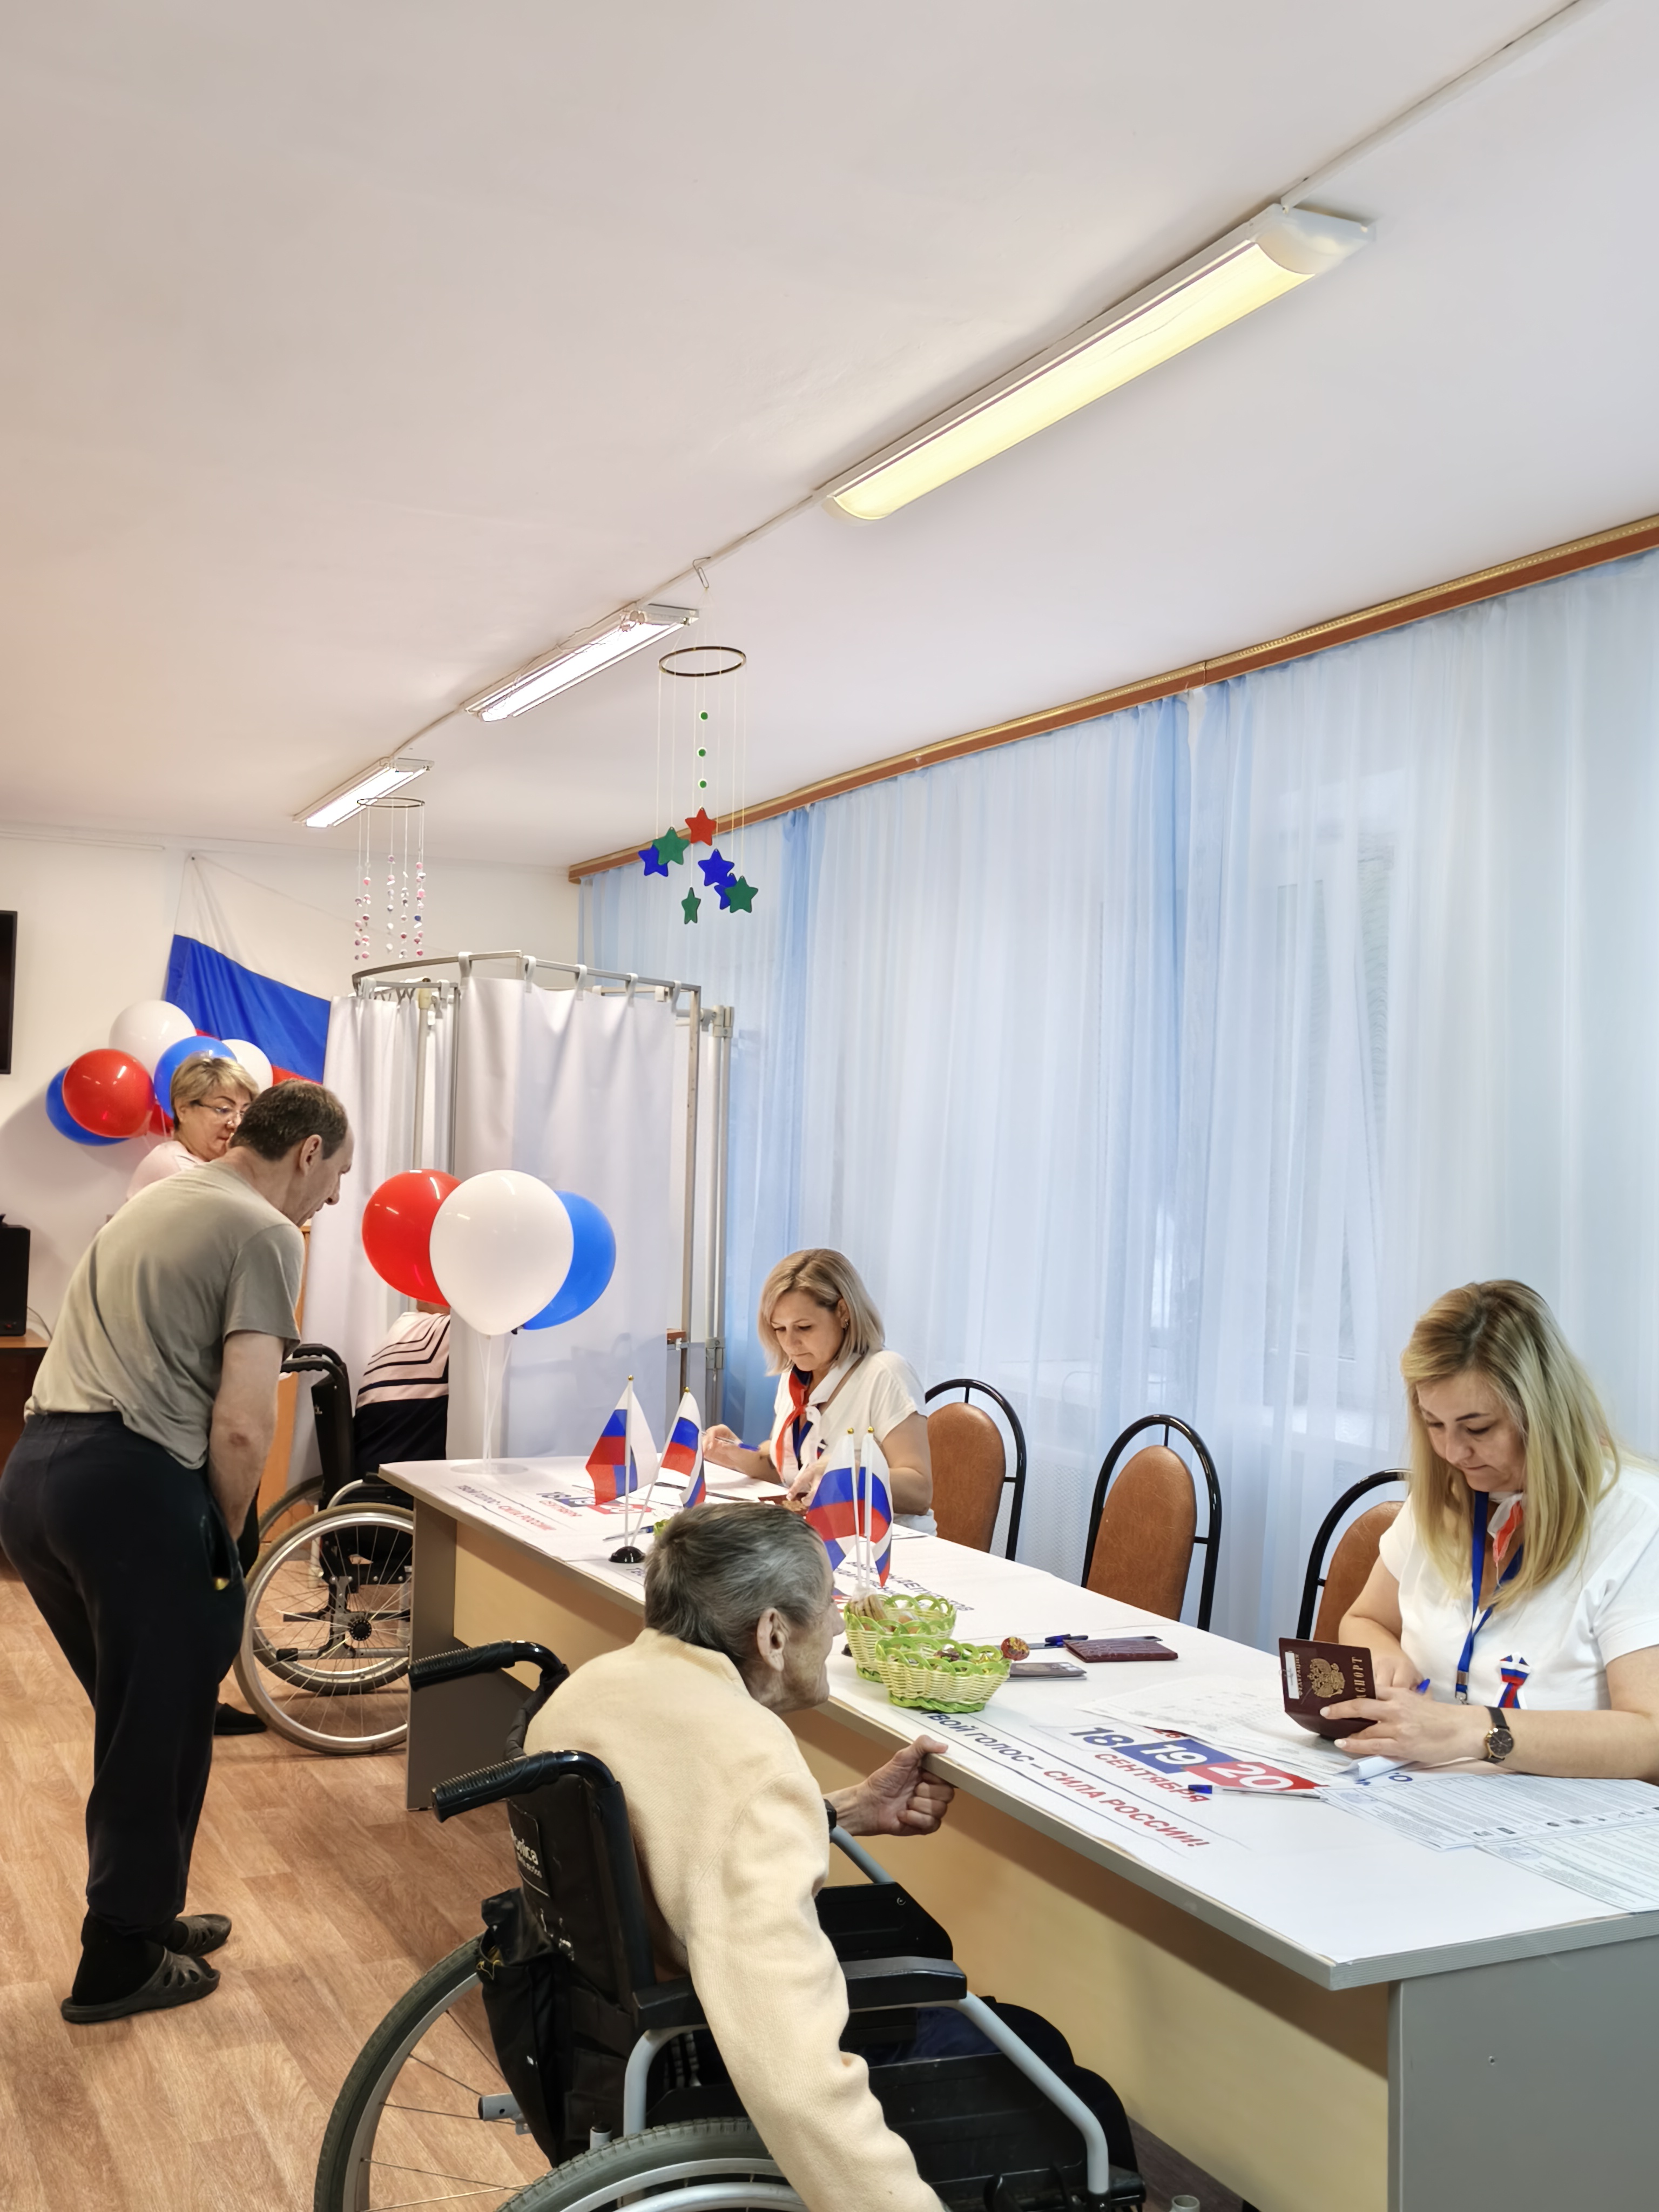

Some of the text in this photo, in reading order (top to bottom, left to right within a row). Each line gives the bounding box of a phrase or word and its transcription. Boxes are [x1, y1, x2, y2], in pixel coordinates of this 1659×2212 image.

[964, 1732, 1035, 1762] ГОЛОС
[1043, 1770, 1107, 1798] СИЛА
[1098, 1799, 1210, 1847] РОССИИ!
[1069, 1727, 1294, 1790] 18 19 20
[1094, 1754, 1211, 1802] СЕНТЯБРЯ
